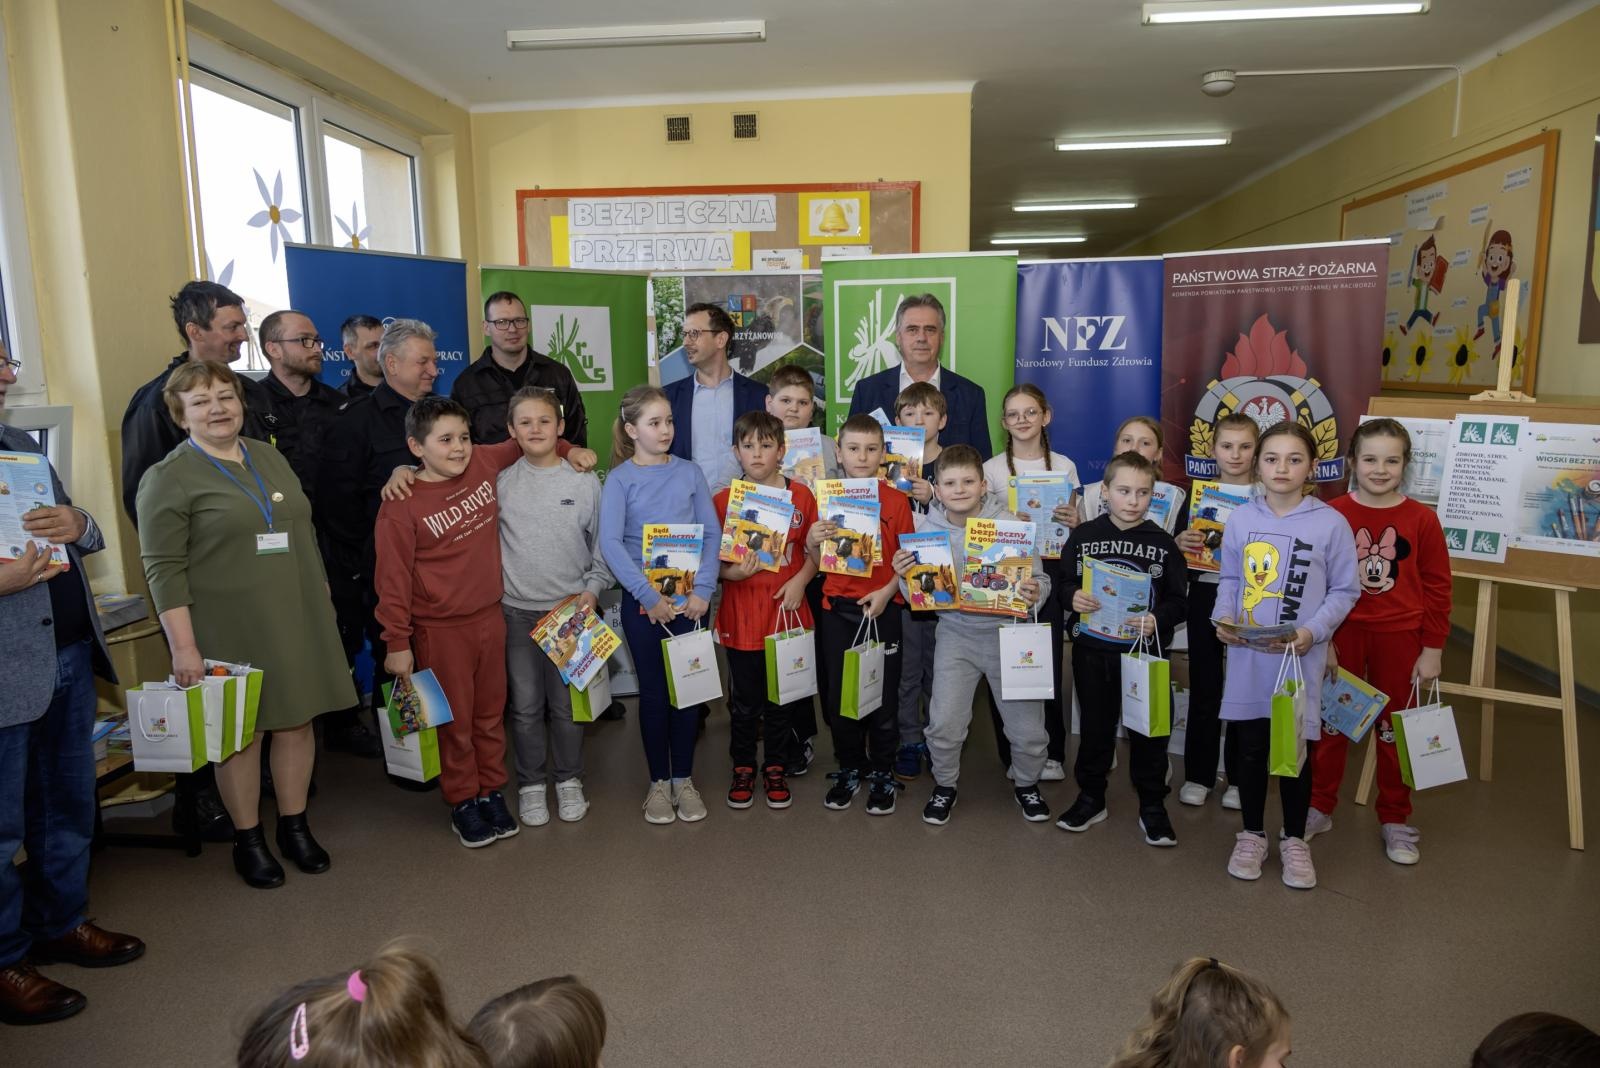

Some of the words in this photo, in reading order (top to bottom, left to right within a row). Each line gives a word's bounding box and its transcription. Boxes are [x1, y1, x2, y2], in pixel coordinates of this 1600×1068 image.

[574, 200, 776, 226] BEZPIECZNA
[574, 238, 732, 263] PRZERWA
[1173, 269, 1259, 284] PAŃSTWOWA
[1263, 263, 1305, 279] STRAŻ
[1309, 261, 1377, 276] POŻARNA
[1237, 286, 1276, 294] PAŃSTWOWEJ
[1300, 283, 1331, 291] POŻARNEJ
[1041, 315, 1128, 351] NFZ
[1016, 358, 1065, 369] Narodowy
[1068, 357, 1109, 367] Fundusz
[1113, 356, 1153, 366] Zdrowia
[1188, 460, 1219, 475] PAŃST
[1314, 464, 1339, 478] RNA
[1536, 455, 1567, 463] WIOSKI
[422, 506, 463, 539] WILD
[460, 480, 496, 515] RIVER
[970, 528, 1026, 539] bezpieczny
[979, 536, 1032, 546] gospodarstwie
[1279, 538, 1313, 625] WEETY
